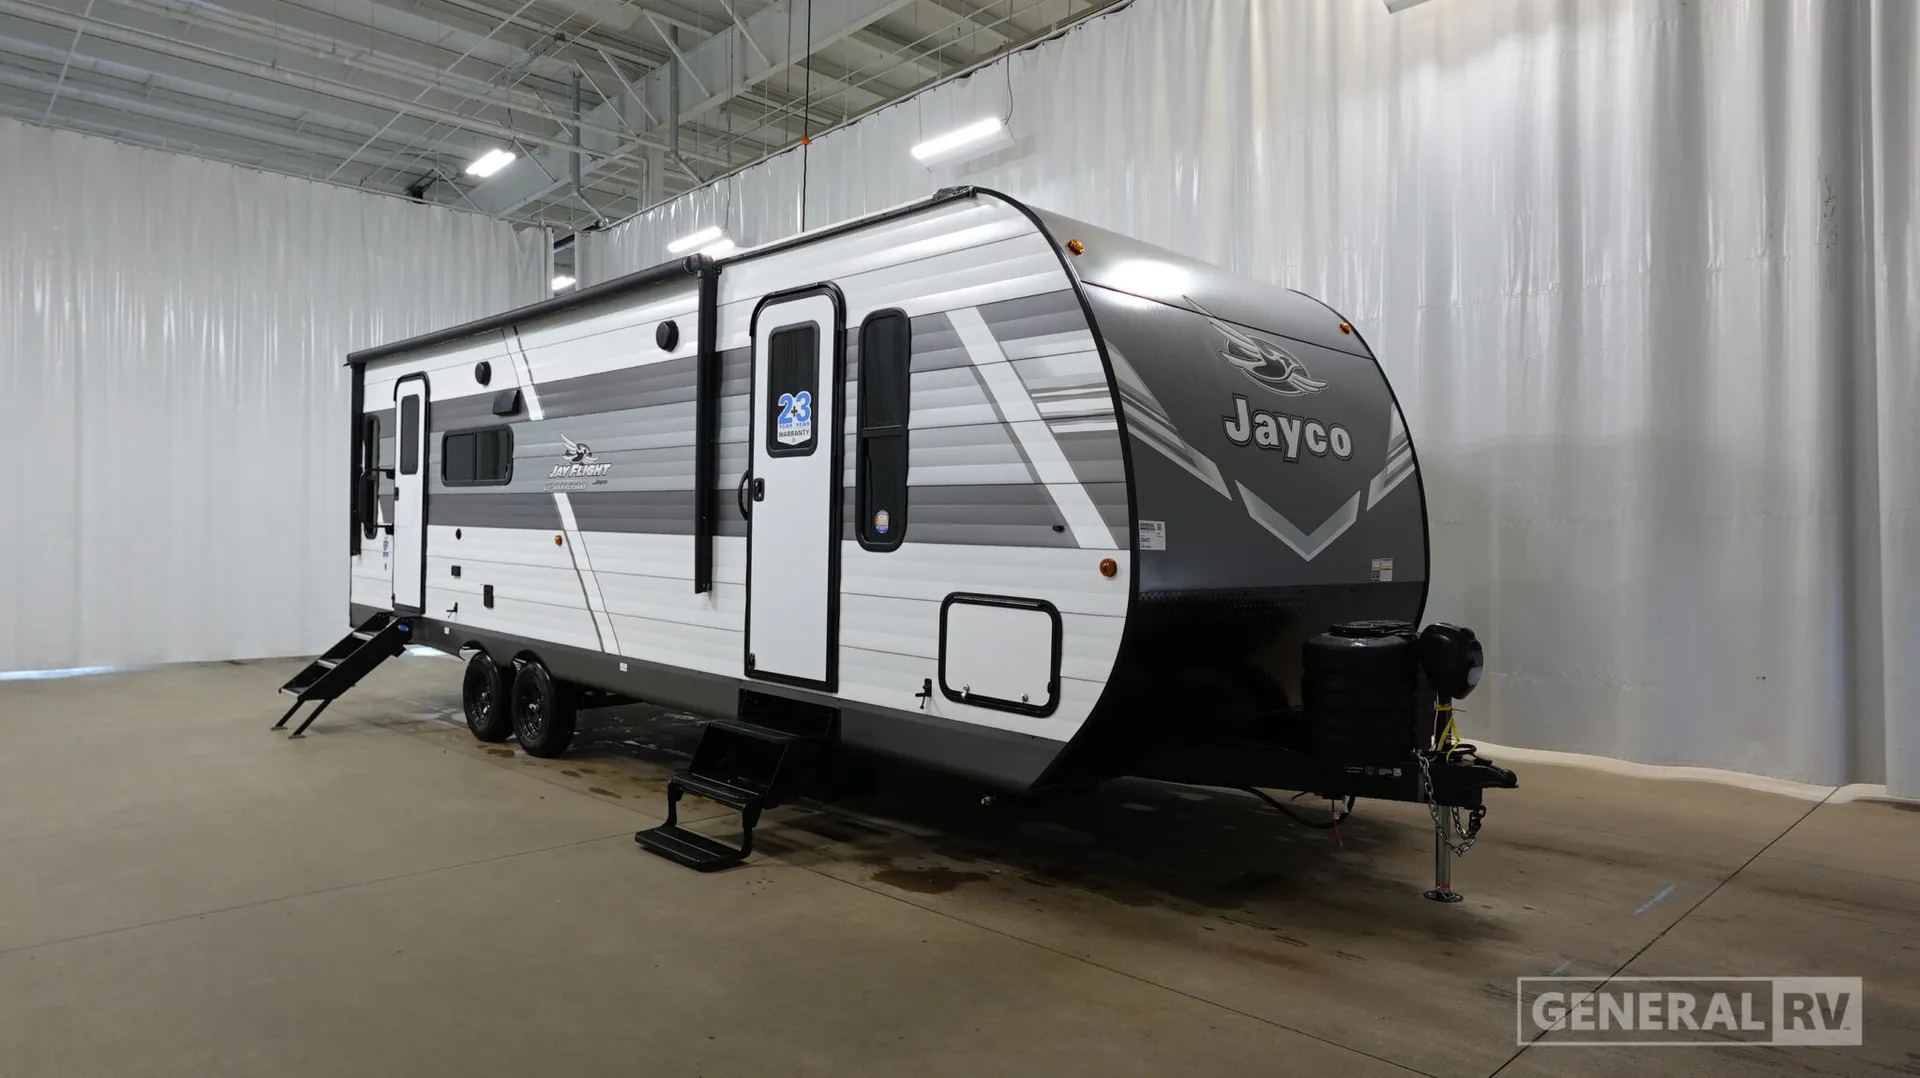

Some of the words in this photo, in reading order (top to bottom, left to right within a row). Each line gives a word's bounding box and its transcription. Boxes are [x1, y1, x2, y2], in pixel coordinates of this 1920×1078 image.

[778, 429, 810, 438] WARRANTY
[1222, 393, 1354, 463] Jayco
[548, 464, 571, 479] JAY
[568, 463, 611, 478] FLIGHT
